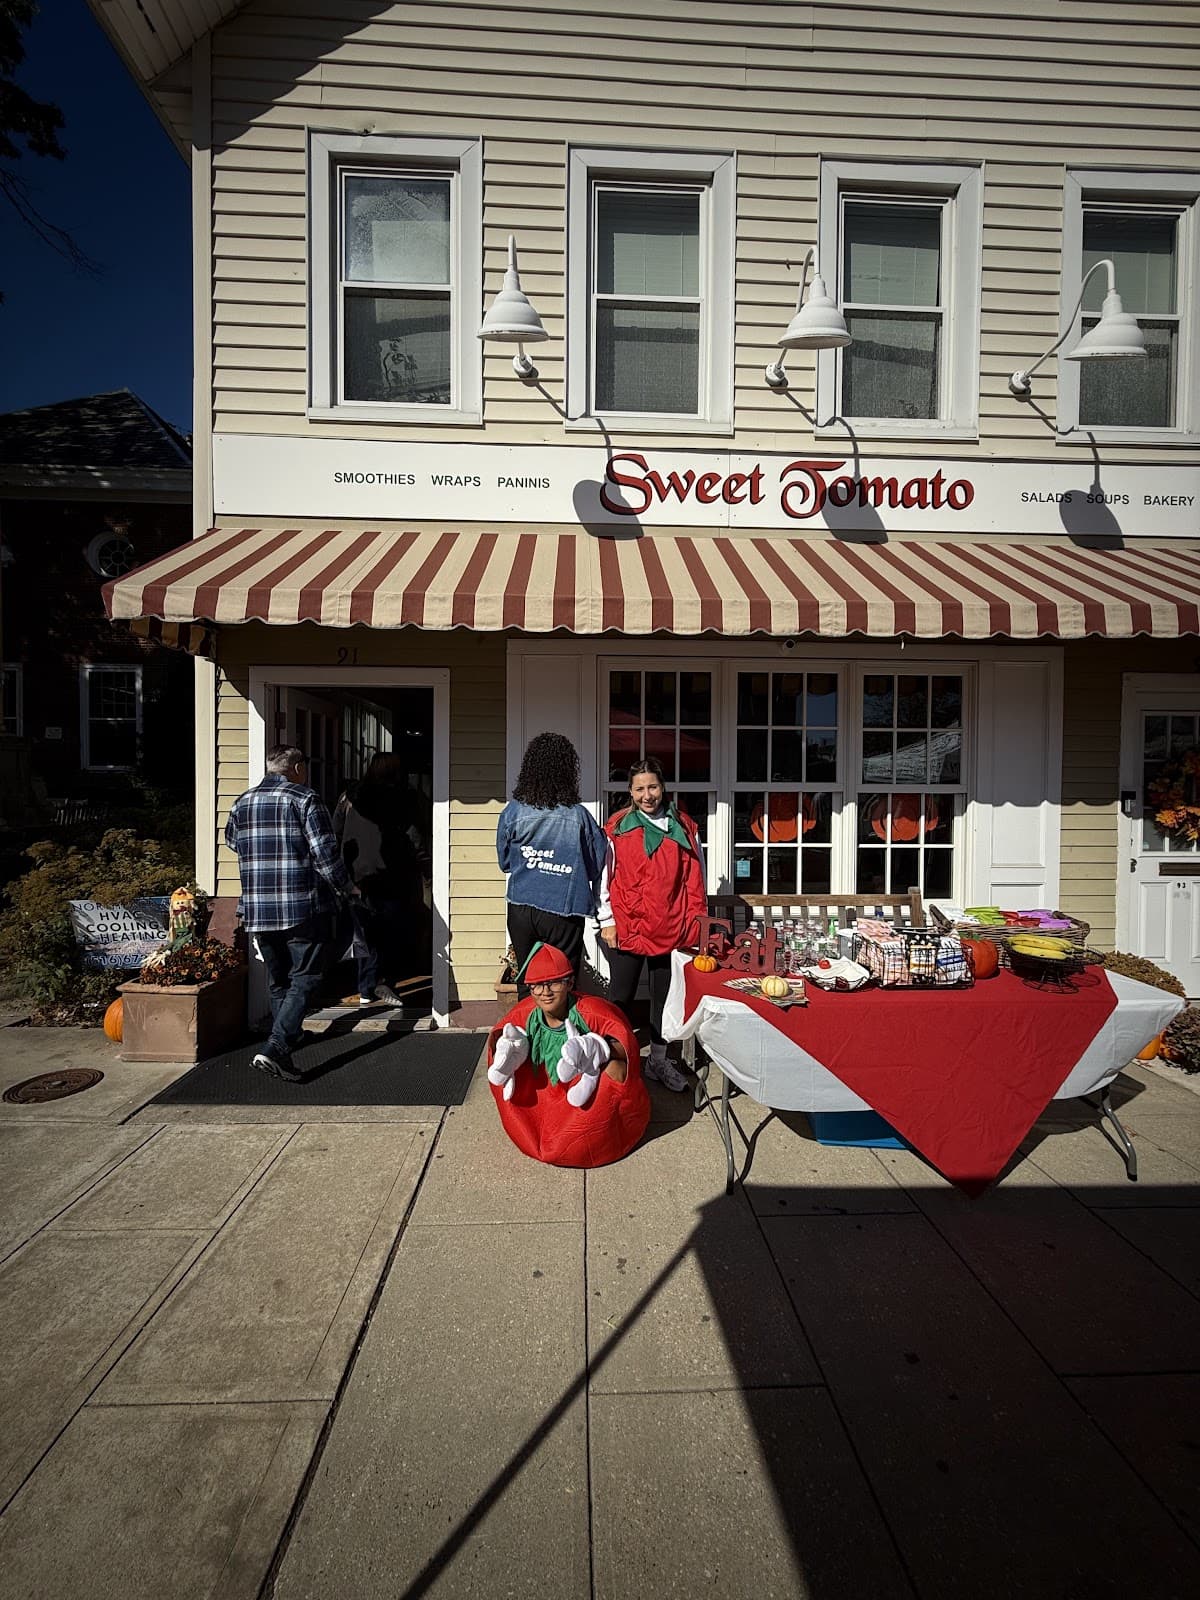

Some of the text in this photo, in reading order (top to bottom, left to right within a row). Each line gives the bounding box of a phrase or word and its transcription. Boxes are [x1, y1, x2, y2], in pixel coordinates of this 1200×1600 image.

[333, 471, 550, 489] SMOOTHIES WRAPS PANINIS
[600, 453, 975, 519] Sweet Tomato
[1021, 492, 1195, 506] SALADS SOUPS BAKERY
[338, 646, 358, 665] 91
[520, 845, 554, 858] Sweet
[526, 858, 572, 873] Tomato
[99, 910, 142, 921] HVAC
[86, 922, 159, 932] COOLING
[99, 930, 167, 942] HEATING
